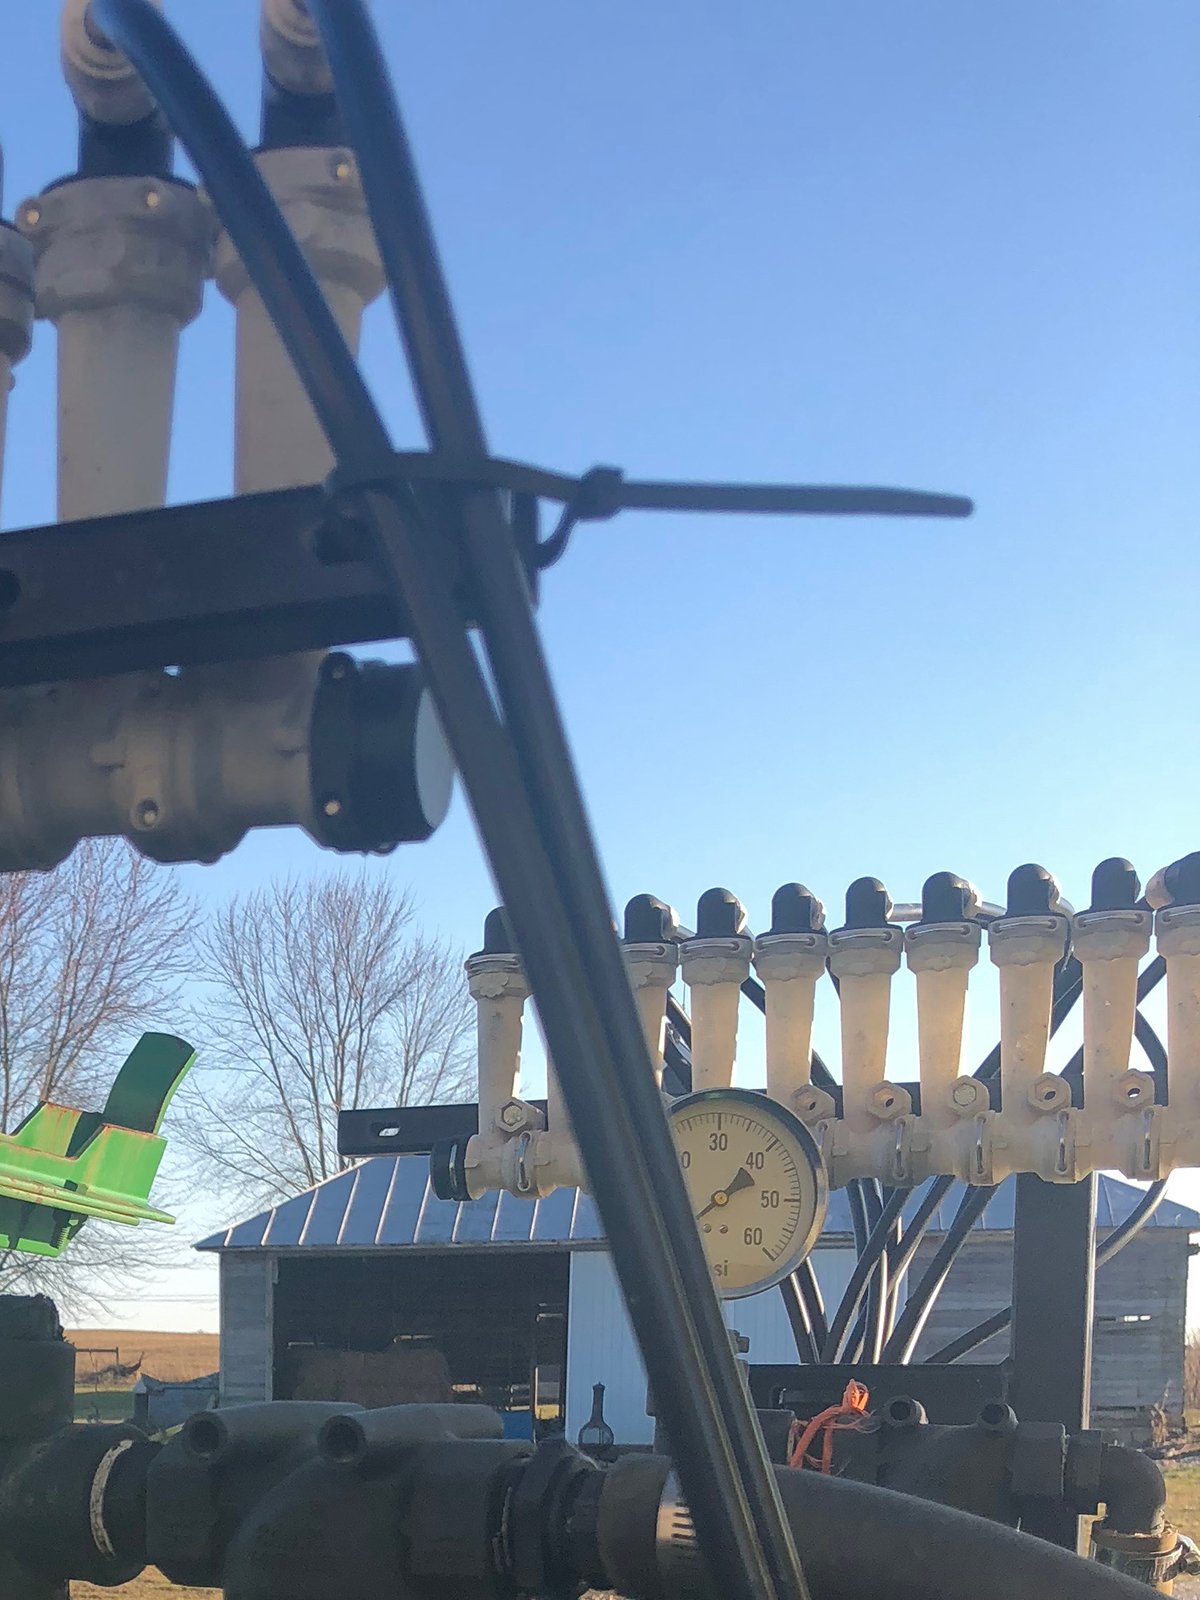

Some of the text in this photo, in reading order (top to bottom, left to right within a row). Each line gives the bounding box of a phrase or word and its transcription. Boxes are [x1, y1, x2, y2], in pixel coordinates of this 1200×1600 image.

[709, 1133, 728, 1151] 30
[746, 1151, 764, 1170] 40
[761, 1190, 780, 1208] 50
[744, 1227, 762, 1246] 60
[713, 1260, 729, 1277] si
